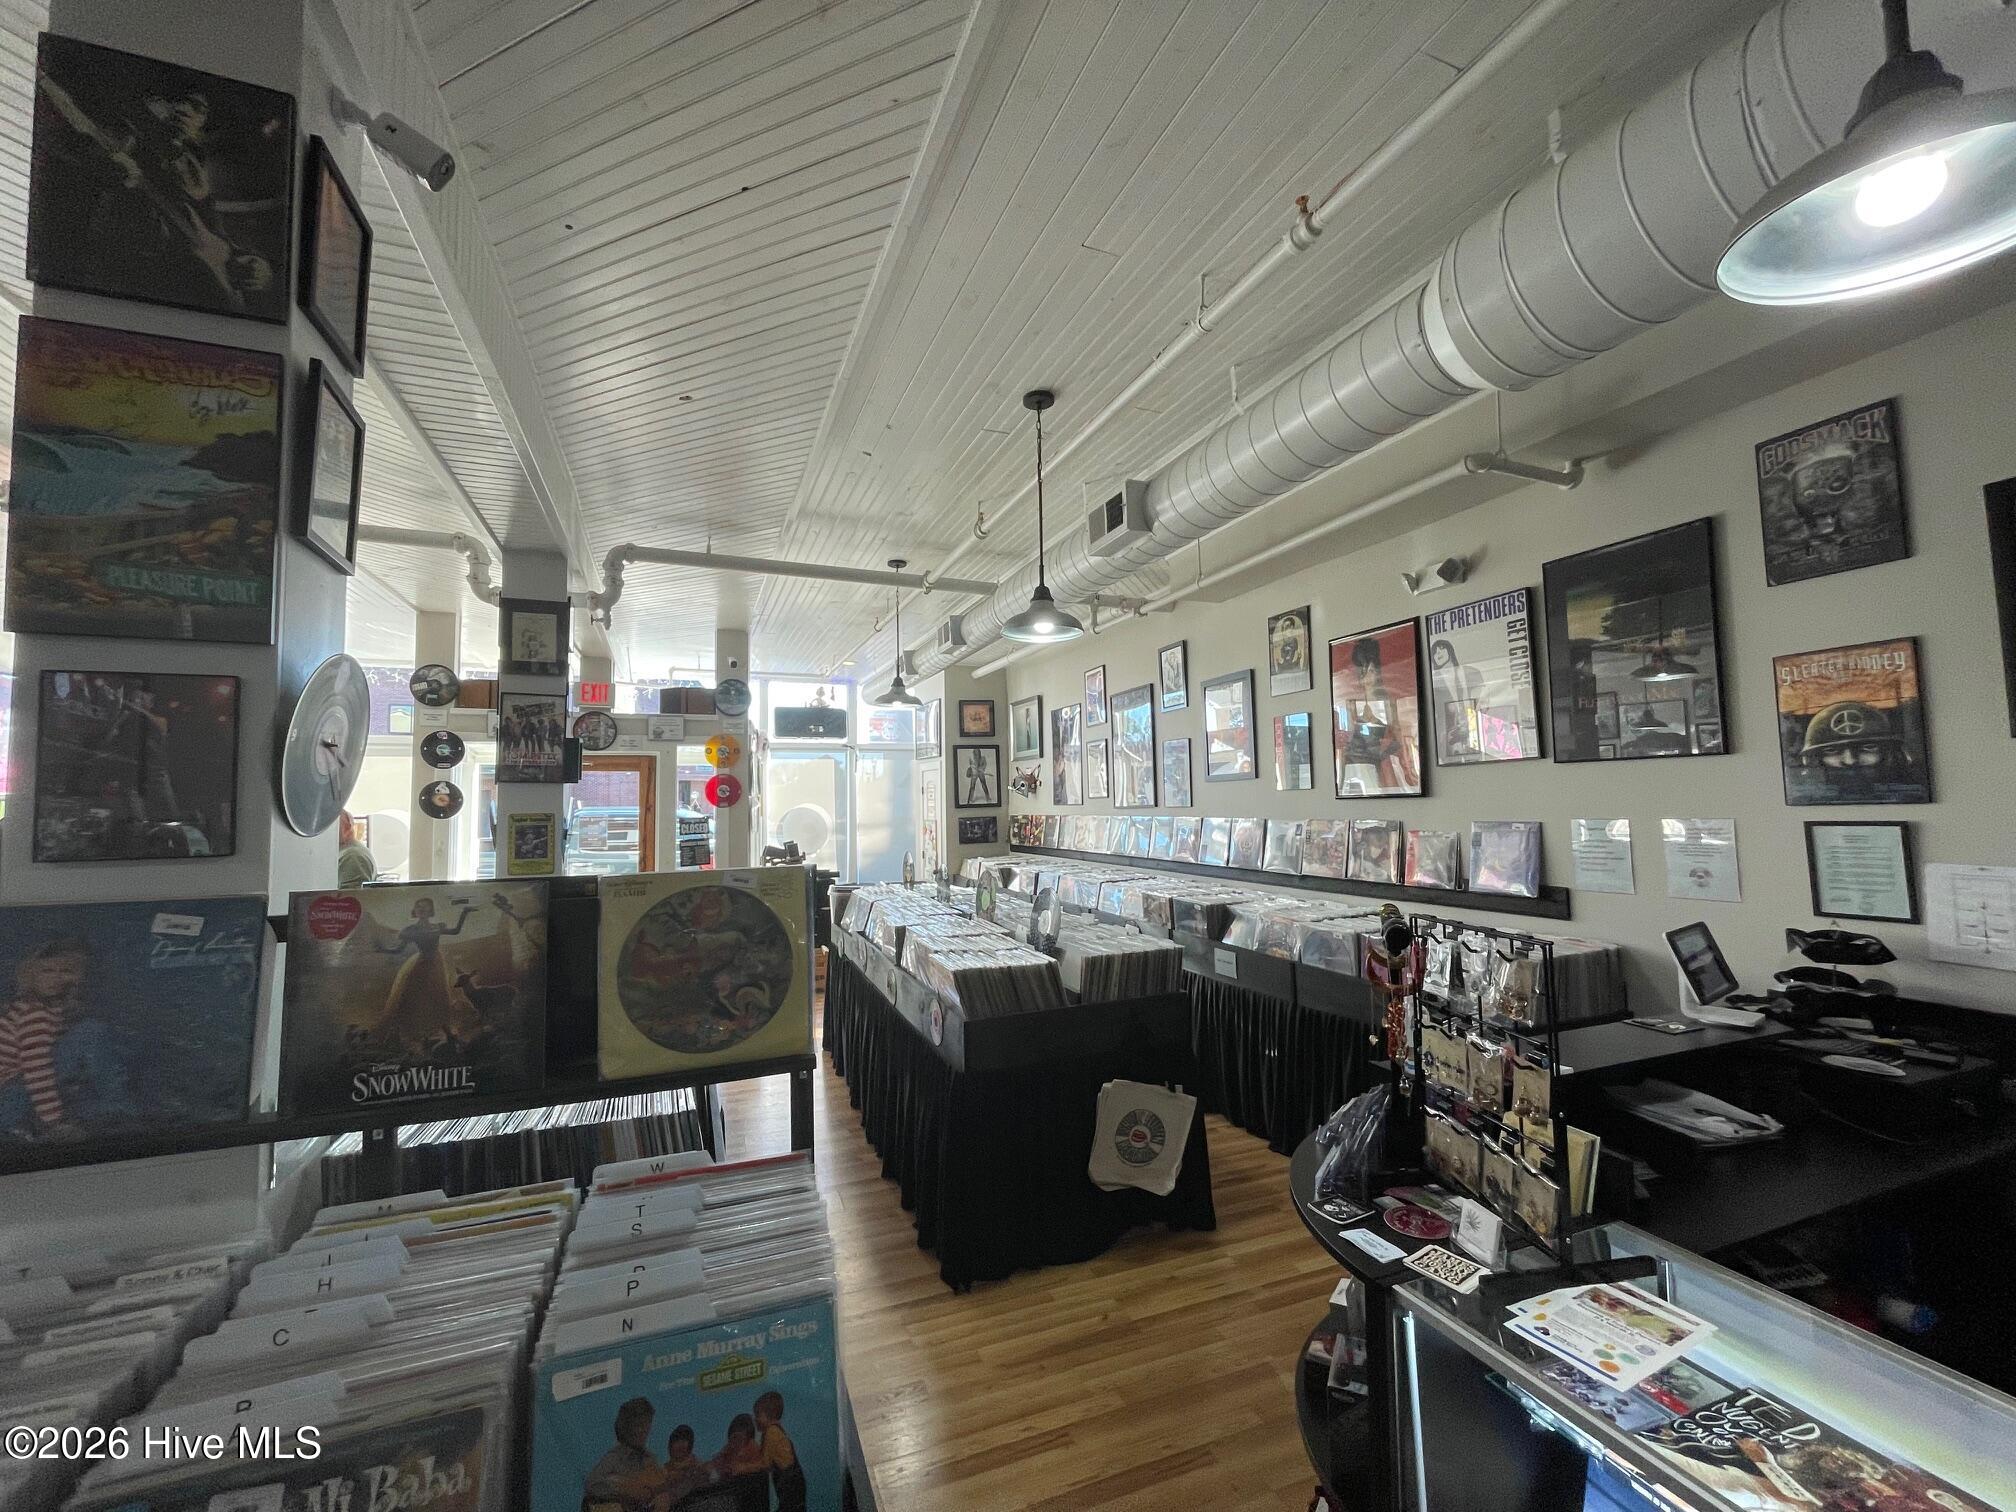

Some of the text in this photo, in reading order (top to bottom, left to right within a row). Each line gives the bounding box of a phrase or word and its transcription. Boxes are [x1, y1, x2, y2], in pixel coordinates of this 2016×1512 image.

[1429, 591, 1526, 636] THE PRETENDERS
[1507, 617, 1531, 689] GET CLOSE
[580, 682, 609, 704] EXIT
[681, 823, 708, 834] CLOSED
[409, 1065, 476, 1092] WHITE
[651, 1161, 665, 1174] W
[635, 1204, 646, 1218] T
[631, 1222, 643, 1236] S
[318, 1277, 332, 1293] H
[626, 1279, 640, 1297] P
[622, 1317, 634, 1333] N
[273, 1328, 290, 1347] C
[696, 1331, 768, 1359] Murray
[768, 1320, 819, 1343] Sings
[734, 1362, 762, 1380] STREET
[1735, 1388, 1821, 1441] TED
[1712, 1402, 1802, 1450] NUGENT
